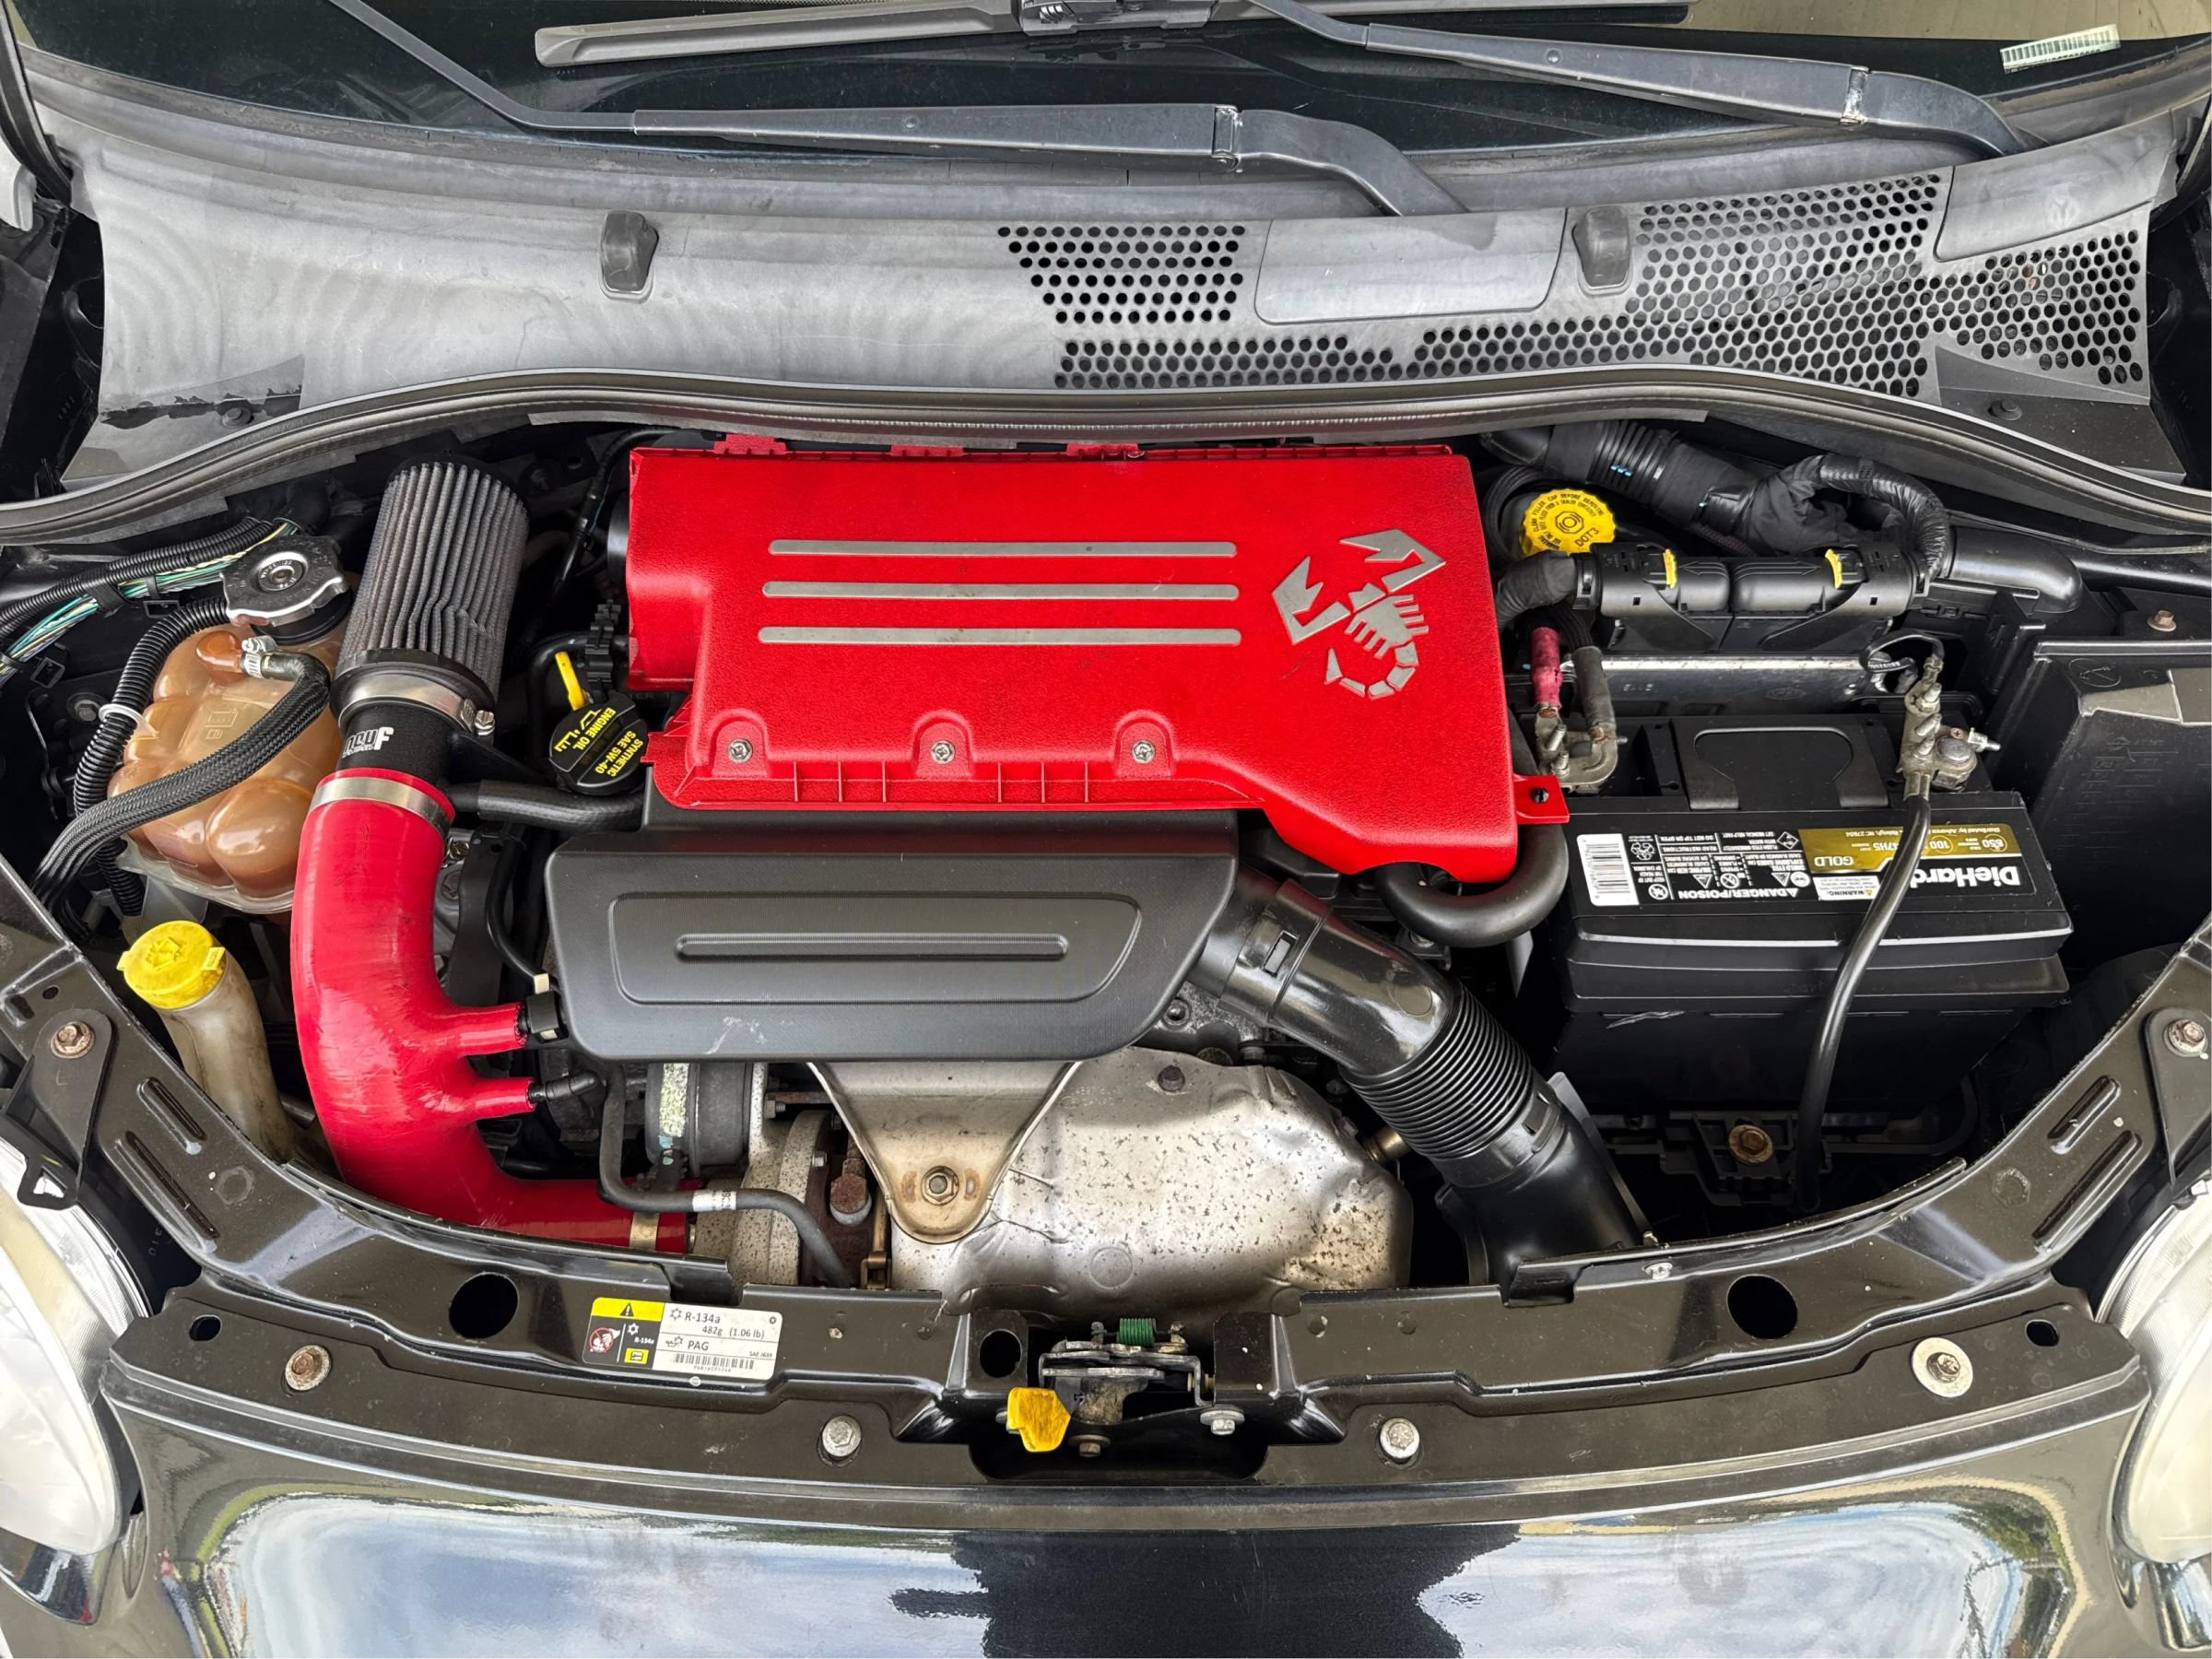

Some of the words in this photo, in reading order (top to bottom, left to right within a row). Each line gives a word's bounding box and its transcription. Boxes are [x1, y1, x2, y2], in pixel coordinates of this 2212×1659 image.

[585, 707, 617, 738] ENGINE
[572, 735, 590, 751] OIL
[617, 730, 637, 749] SAE
[594, 747, 621, 774] 5W-40
[606, 738, 643, 777] SYNTHETIC
[1929, 841, 1948, 849] 100
[1814, 855, 1854, 866] GOLD
[1910, 866, 2020, 888] DieHard
[1677, 888, 1787, 899] DANGER/POISON
[684, 1311, 721, 1324] R-134a
[702, 1325, 723, 1336] 482g
[729, 1327, 751, 1338] (1.06
[752, 1329, 765, 1340] lb)
[688, 1339, 710, 1351] PAG
